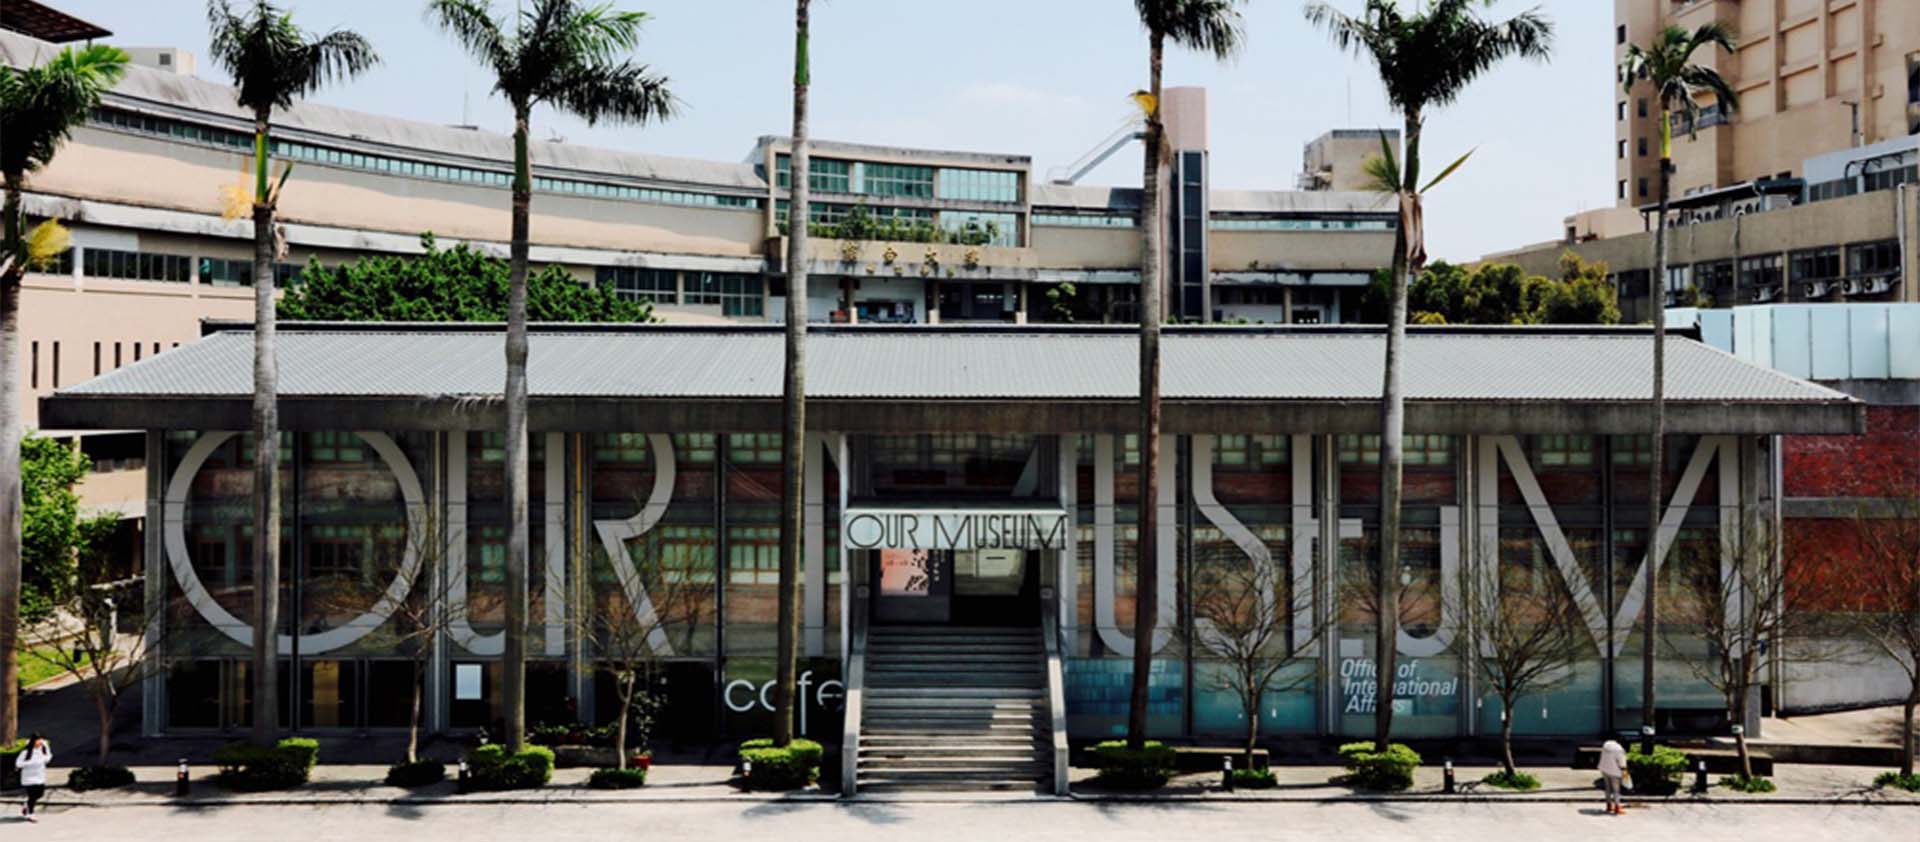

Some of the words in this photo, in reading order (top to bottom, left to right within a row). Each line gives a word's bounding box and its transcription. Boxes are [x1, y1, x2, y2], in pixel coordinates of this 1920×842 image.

[846, 514, 920, 549] OUR
[933, 514, 1068, 550] MUSEUM
[163, 432, 675, 656] OUR
[1340, 658, 1378, 678] Offi
[1397, 659, 1420, 678] of
[1343, 676, 1458, 696] Inteational
[1345, 695, 1405, 713] Affs
